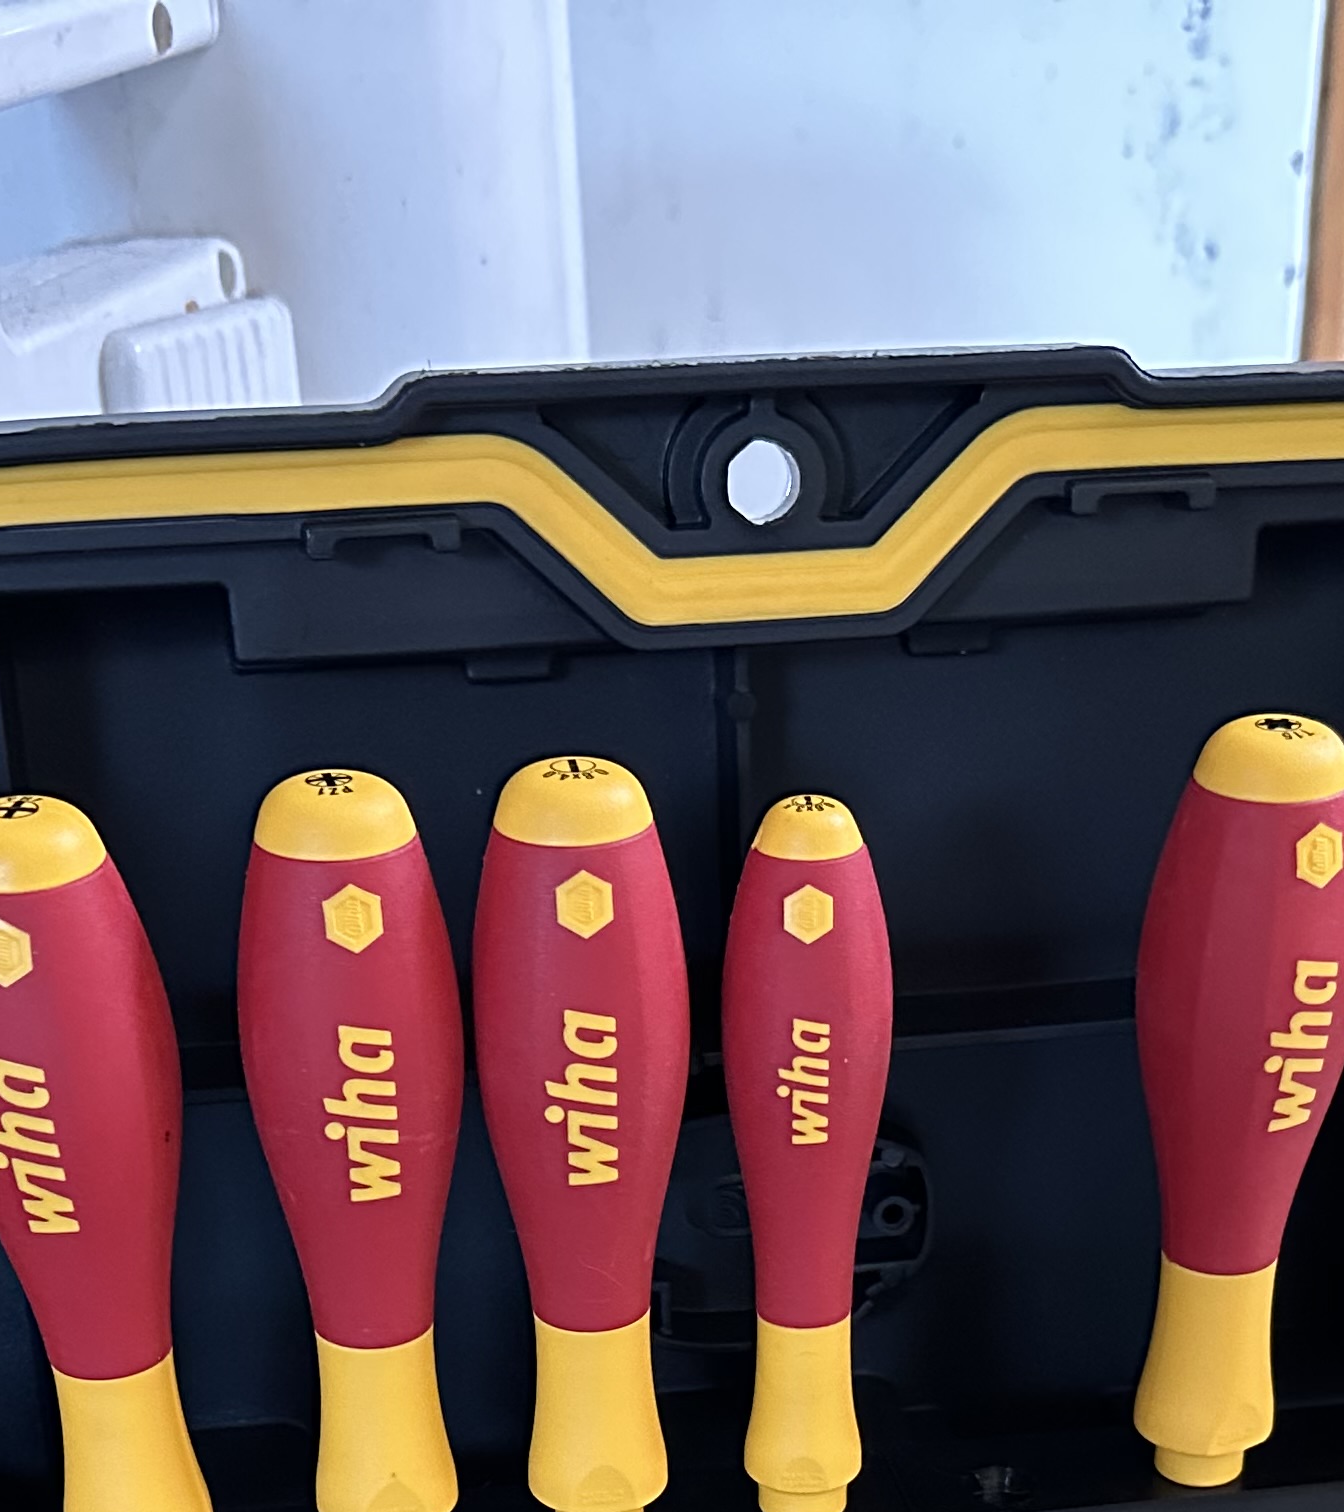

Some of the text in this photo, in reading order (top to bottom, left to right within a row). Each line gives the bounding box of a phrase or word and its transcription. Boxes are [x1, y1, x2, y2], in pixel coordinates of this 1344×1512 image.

[324, 1026, 401, 1201] wiha
[545, 1010, 619, 1185] wiha
[777, 1019, 830, 1144] wiha
[1264, 961, 1339, 1131] wiha
